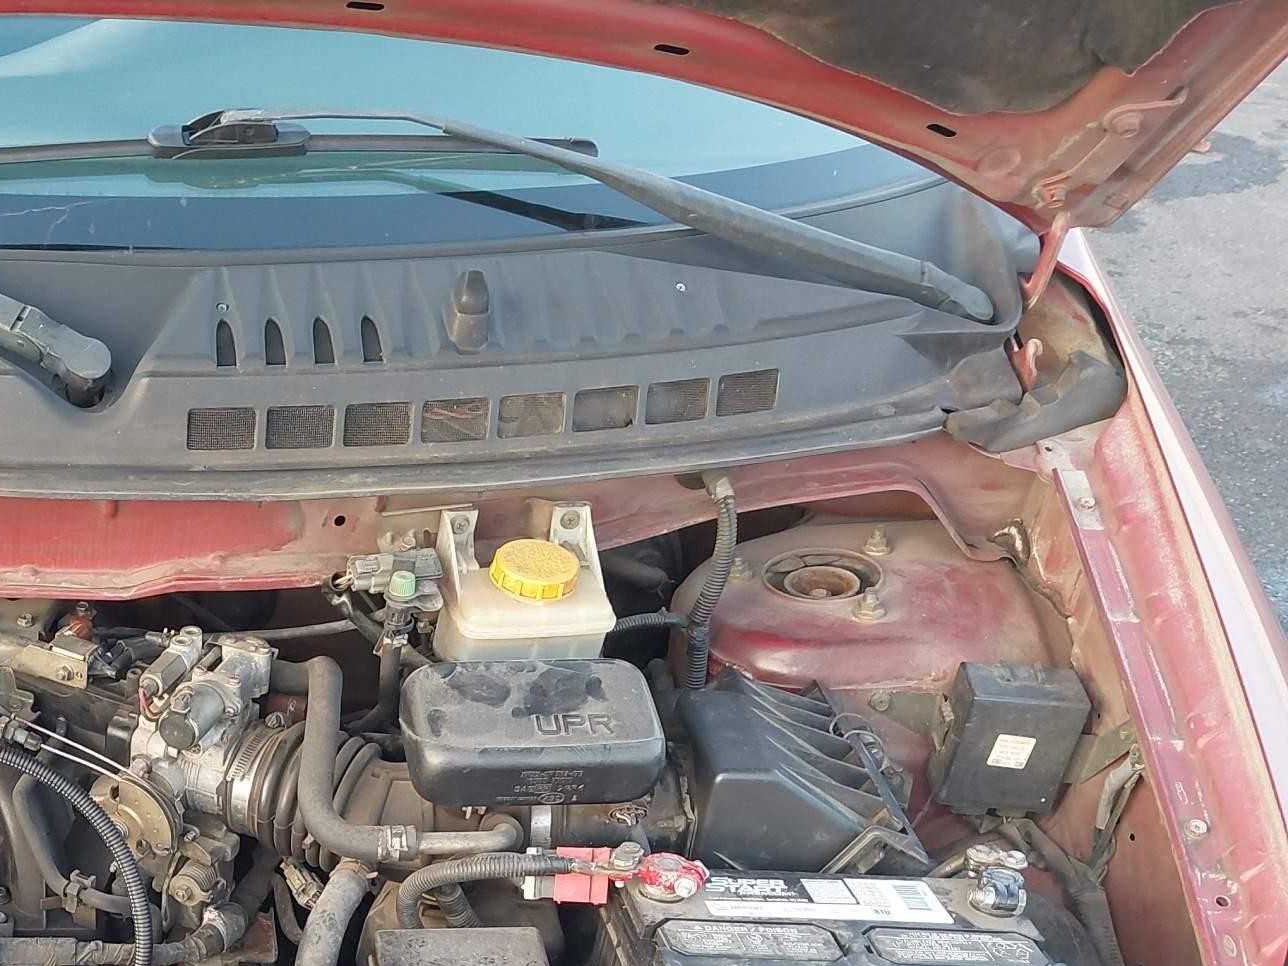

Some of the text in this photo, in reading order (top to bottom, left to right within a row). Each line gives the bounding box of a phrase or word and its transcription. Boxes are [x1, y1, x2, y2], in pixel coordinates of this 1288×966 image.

[711, 877, 785, 887] SUPER
[705, 883, 789, 893] START
[705, 925, 748, 933] DANGER
[758, 926, 799, 934] POISON
